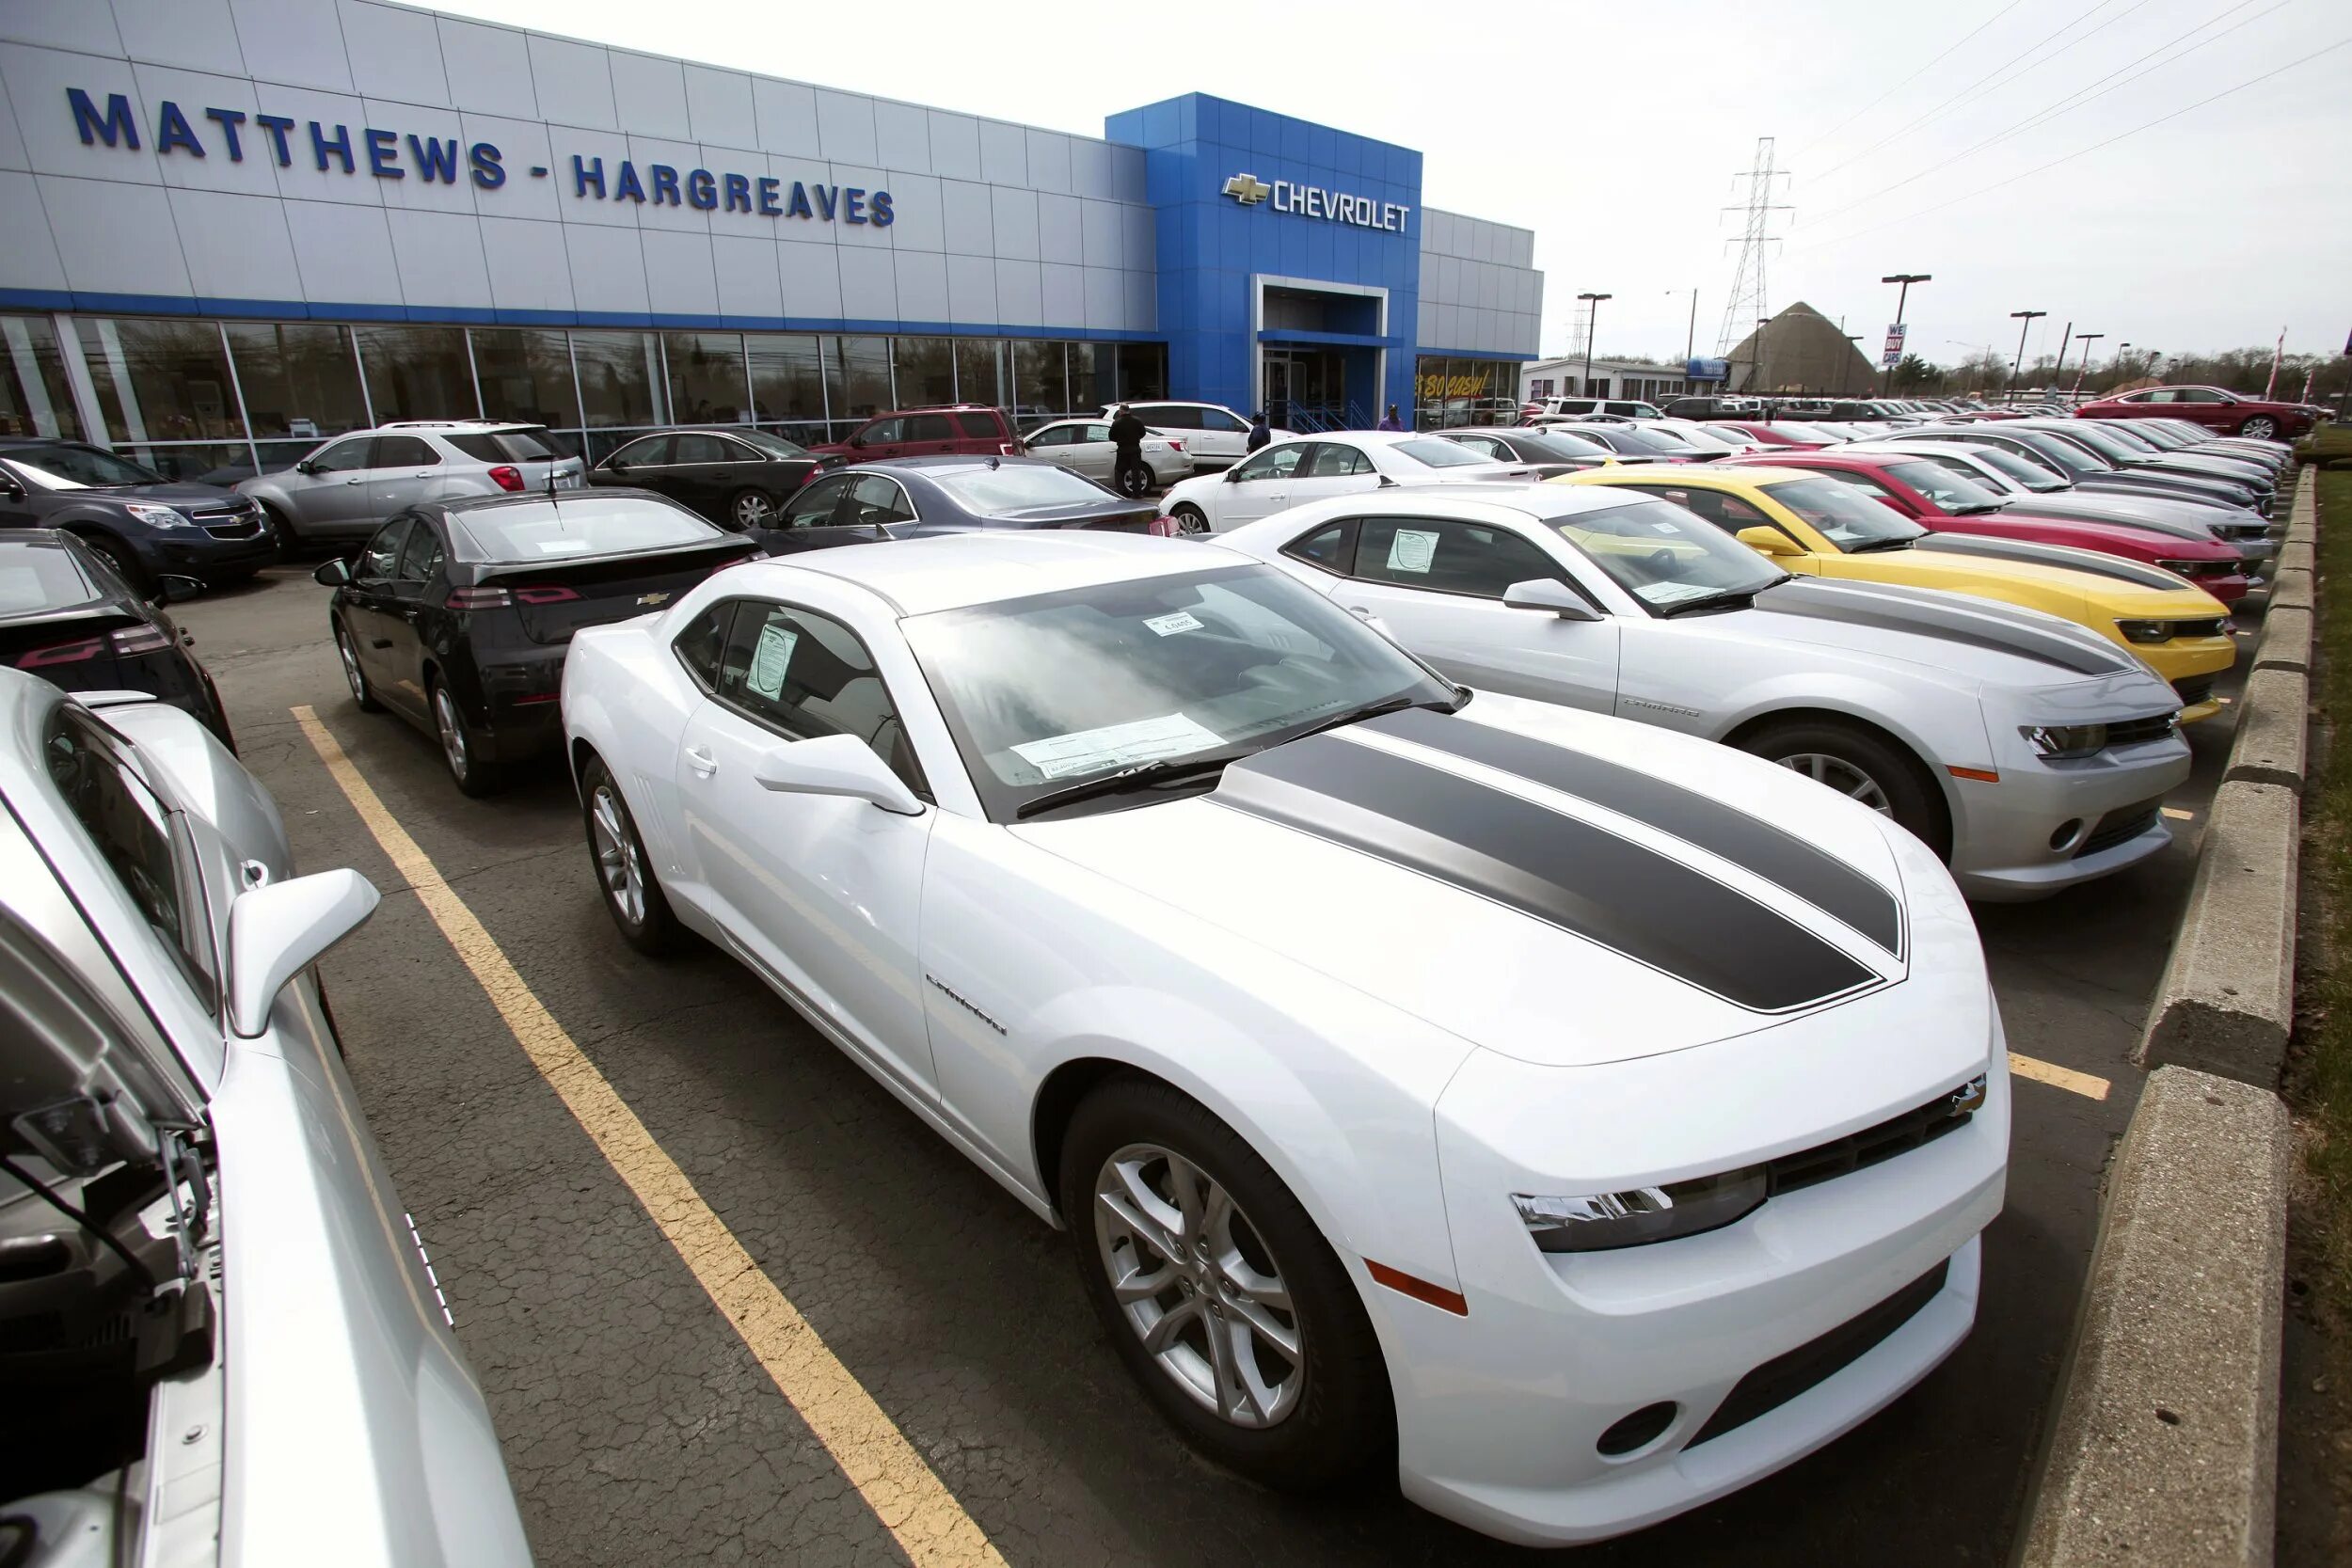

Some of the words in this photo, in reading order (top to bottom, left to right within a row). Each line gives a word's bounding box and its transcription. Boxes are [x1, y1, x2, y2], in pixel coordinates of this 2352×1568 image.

[66, 87, 506, 189] MATTHEWS
[530, 166, 548, 177] -
[570, 154, 896, 228] HARGREAVES
[1273, 180, 1410, 232] CHEVROLET
[1886, 339, 1902, 349] BUY
[1889, 325, 1903, 335] WE
